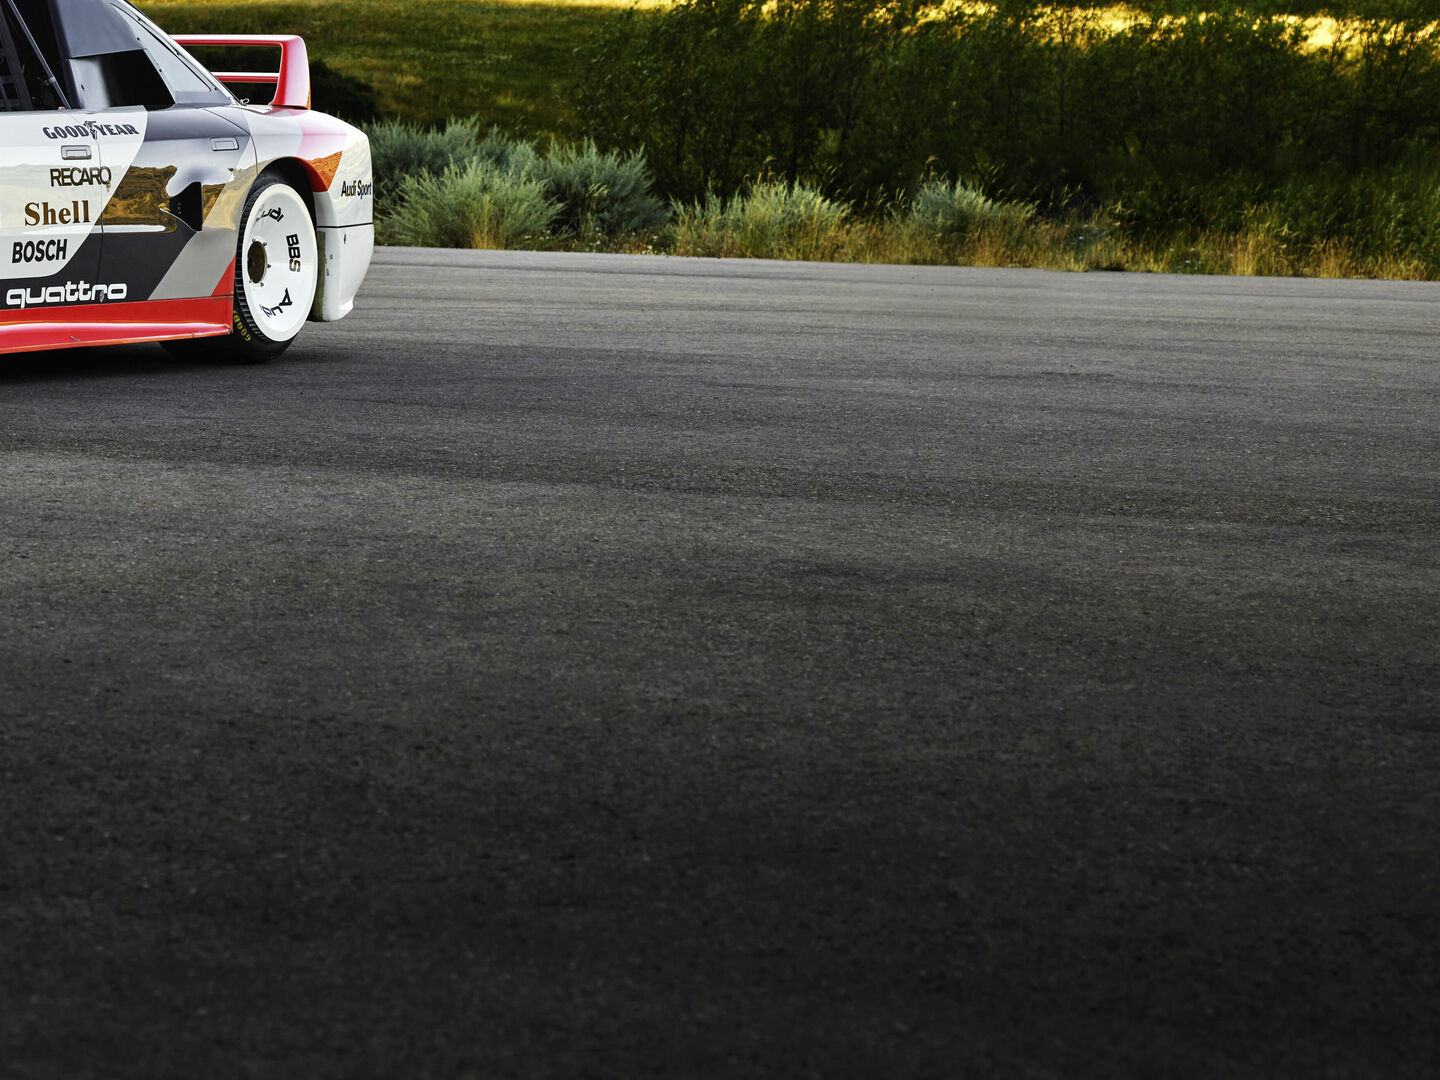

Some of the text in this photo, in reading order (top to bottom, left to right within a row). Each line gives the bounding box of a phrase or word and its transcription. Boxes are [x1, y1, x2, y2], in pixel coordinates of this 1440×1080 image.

[49, 166, 112, 187] RECARO
[341, 179, 372, 200] Audi Sport
[24, 200, 91, 226] Shell
[12, 238, 68, 264] BOSCH
[286, 233, 302, 273] BBS
[6, 280, 128, 309] quattro
